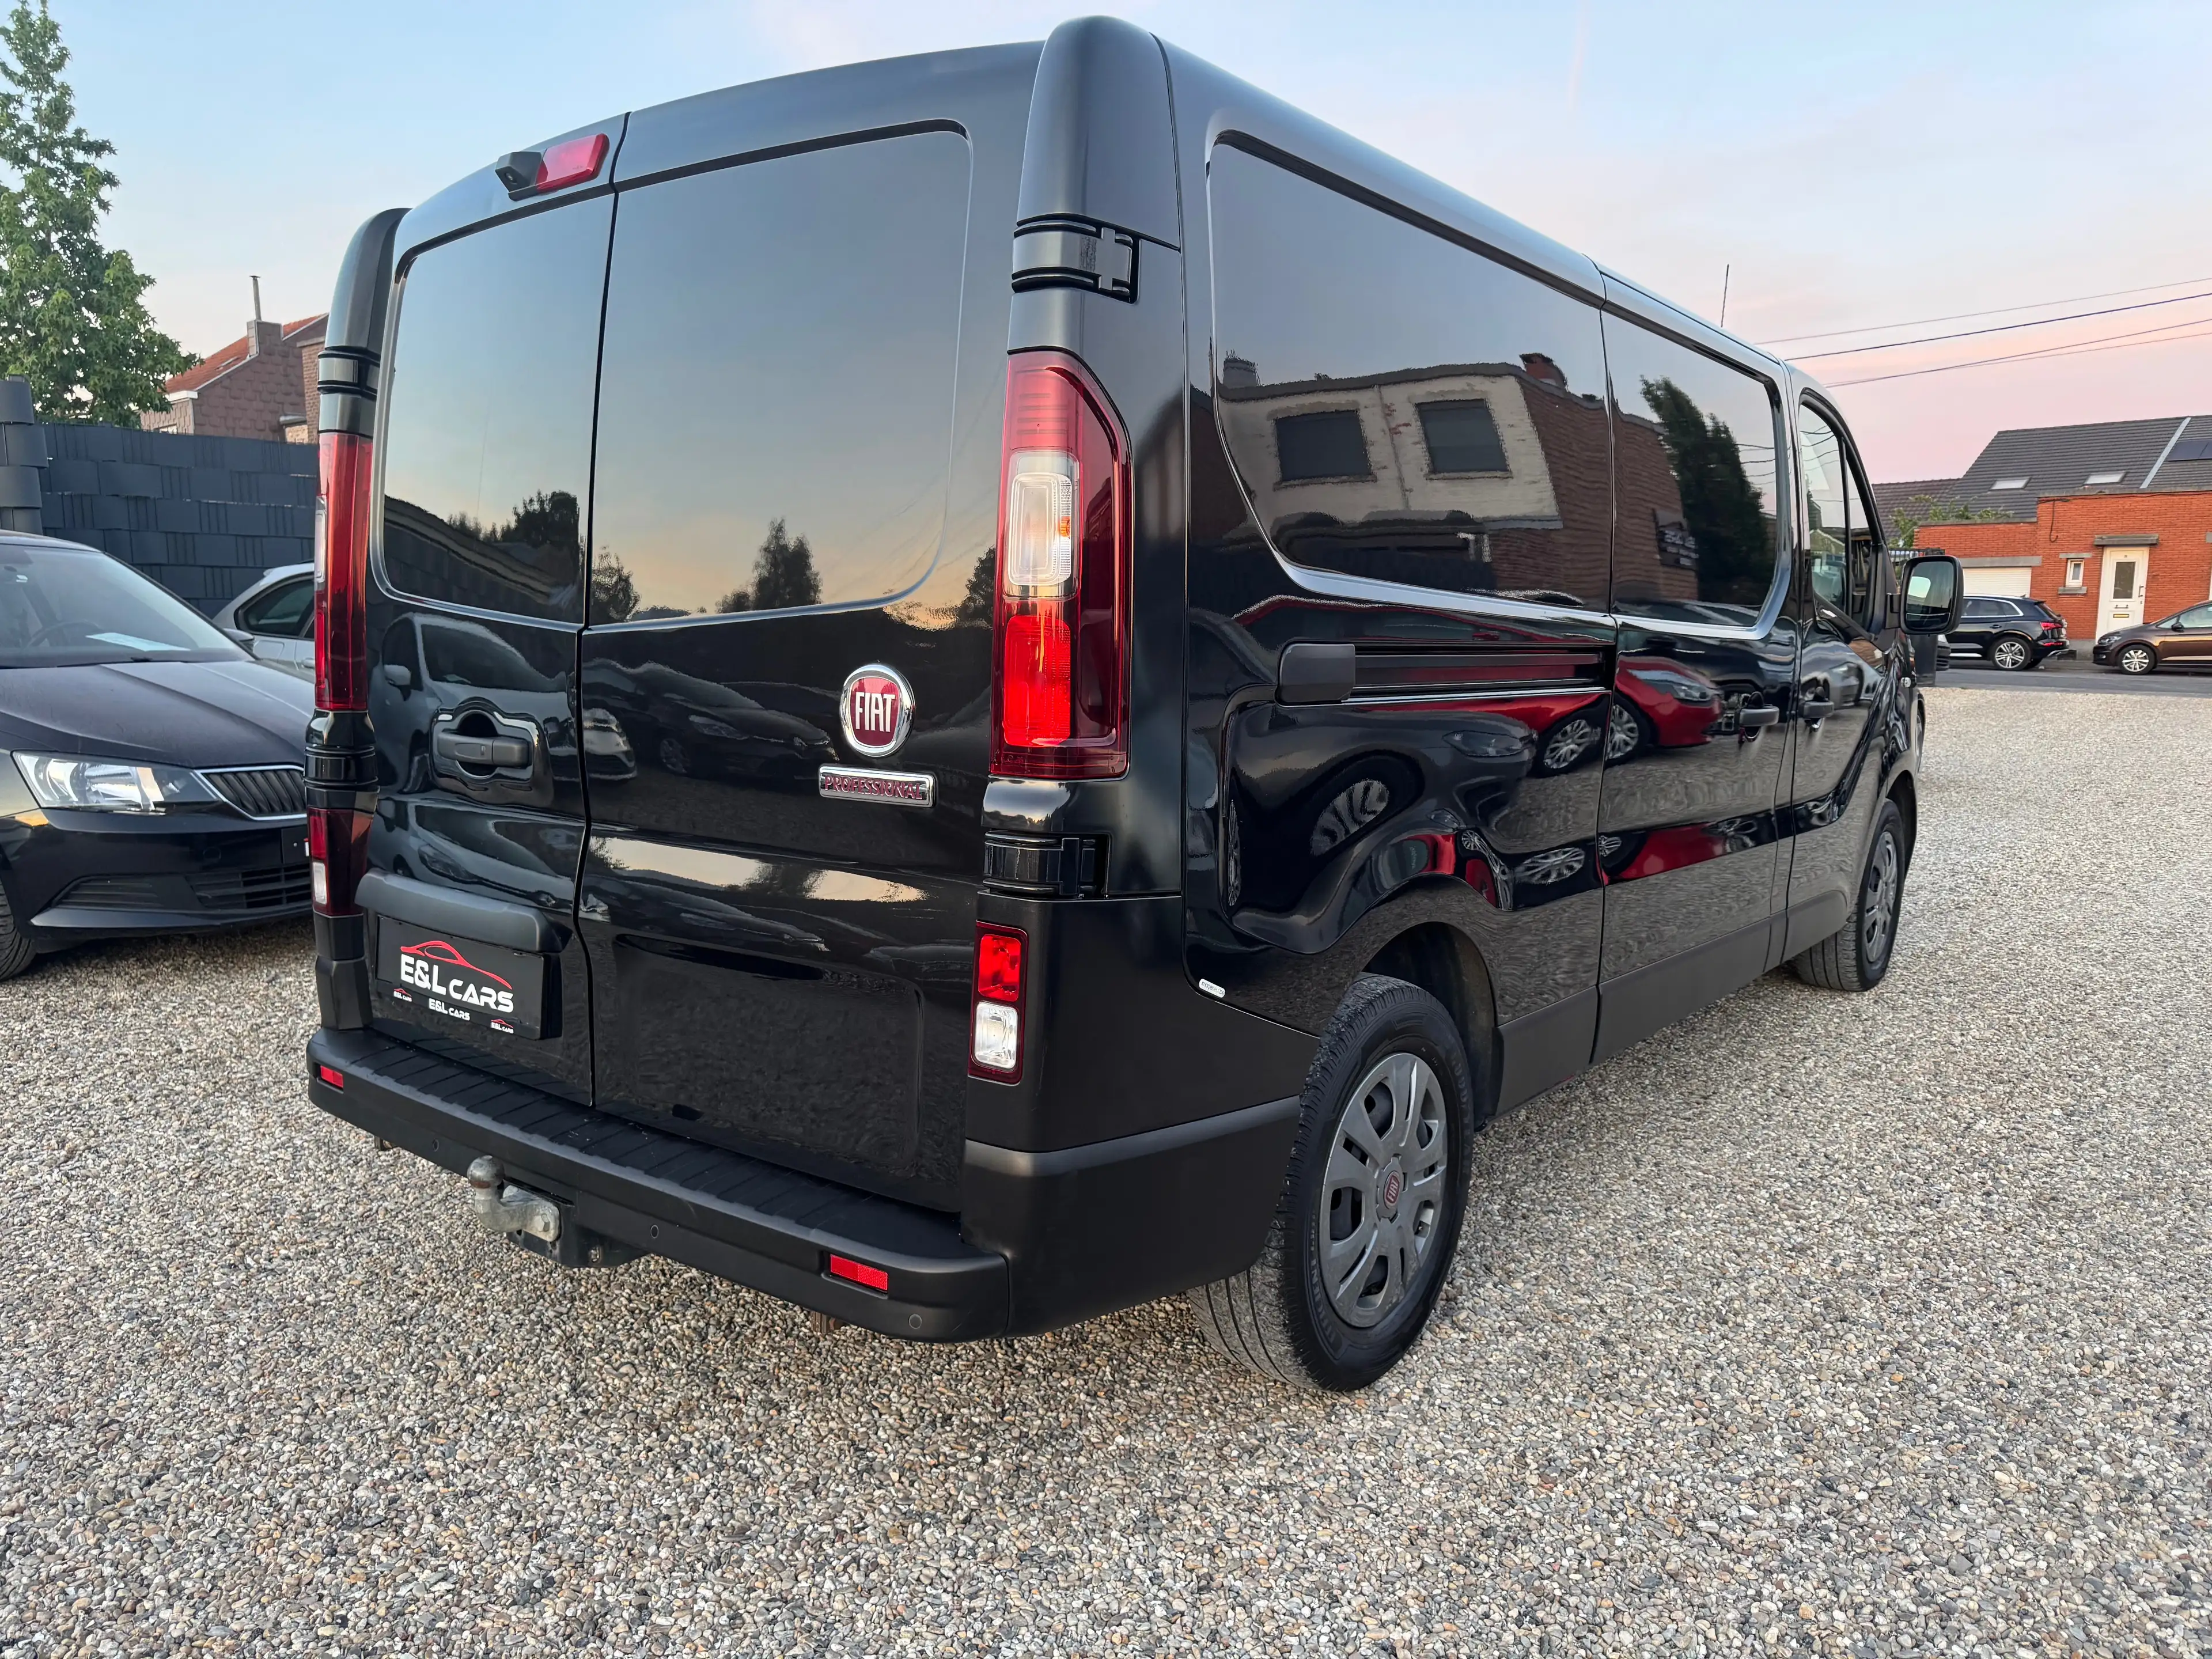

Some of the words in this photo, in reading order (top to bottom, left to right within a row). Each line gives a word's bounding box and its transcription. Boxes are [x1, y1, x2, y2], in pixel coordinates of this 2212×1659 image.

[855, 692, 896, 732] FIAT
[824, 775, 923, 800] PROFESSIONAL
[401, 954, 446, 995] E&L
[449, 979, 514, 1013] CARS
[429, 998, 448, 1014] E&L
[449, 1007, 470, 1021] CARS
[1387, 1178, 1398, 1202] FIAT
